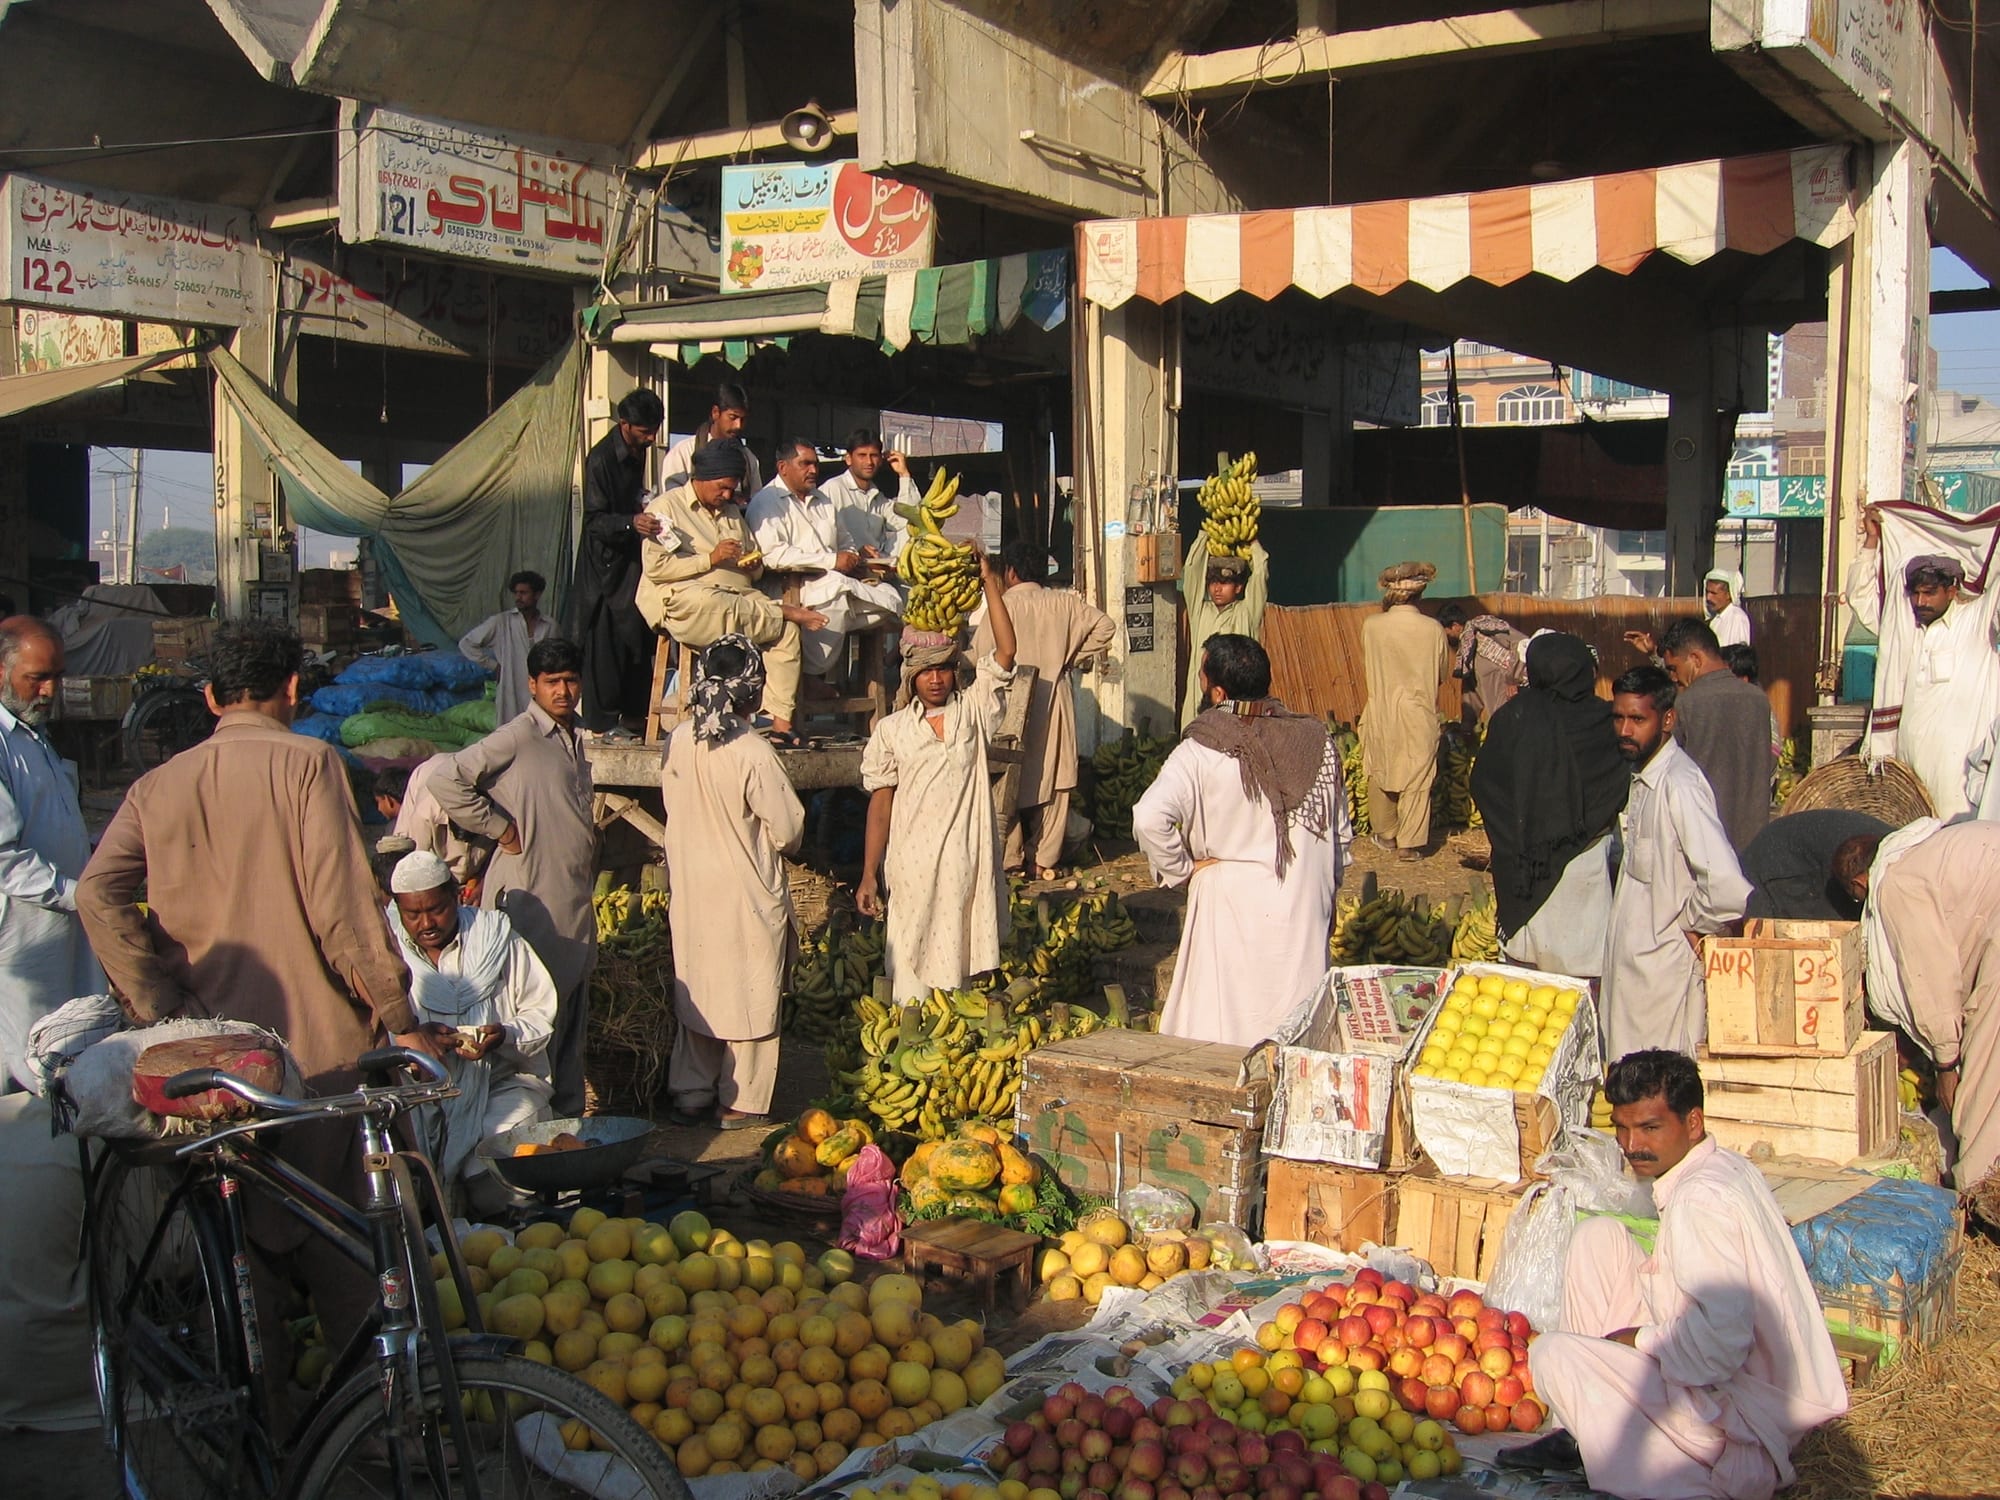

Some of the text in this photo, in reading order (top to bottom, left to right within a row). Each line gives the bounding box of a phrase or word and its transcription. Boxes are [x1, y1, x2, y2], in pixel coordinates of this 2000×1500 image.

[380, 190, 415, 236] 121
[23, 256, 74, 294] 122
[216, 440, 226, 509] 123
[1794, 956, 1837, 987] 35
[1378, 1018, 1393, 1034] his
